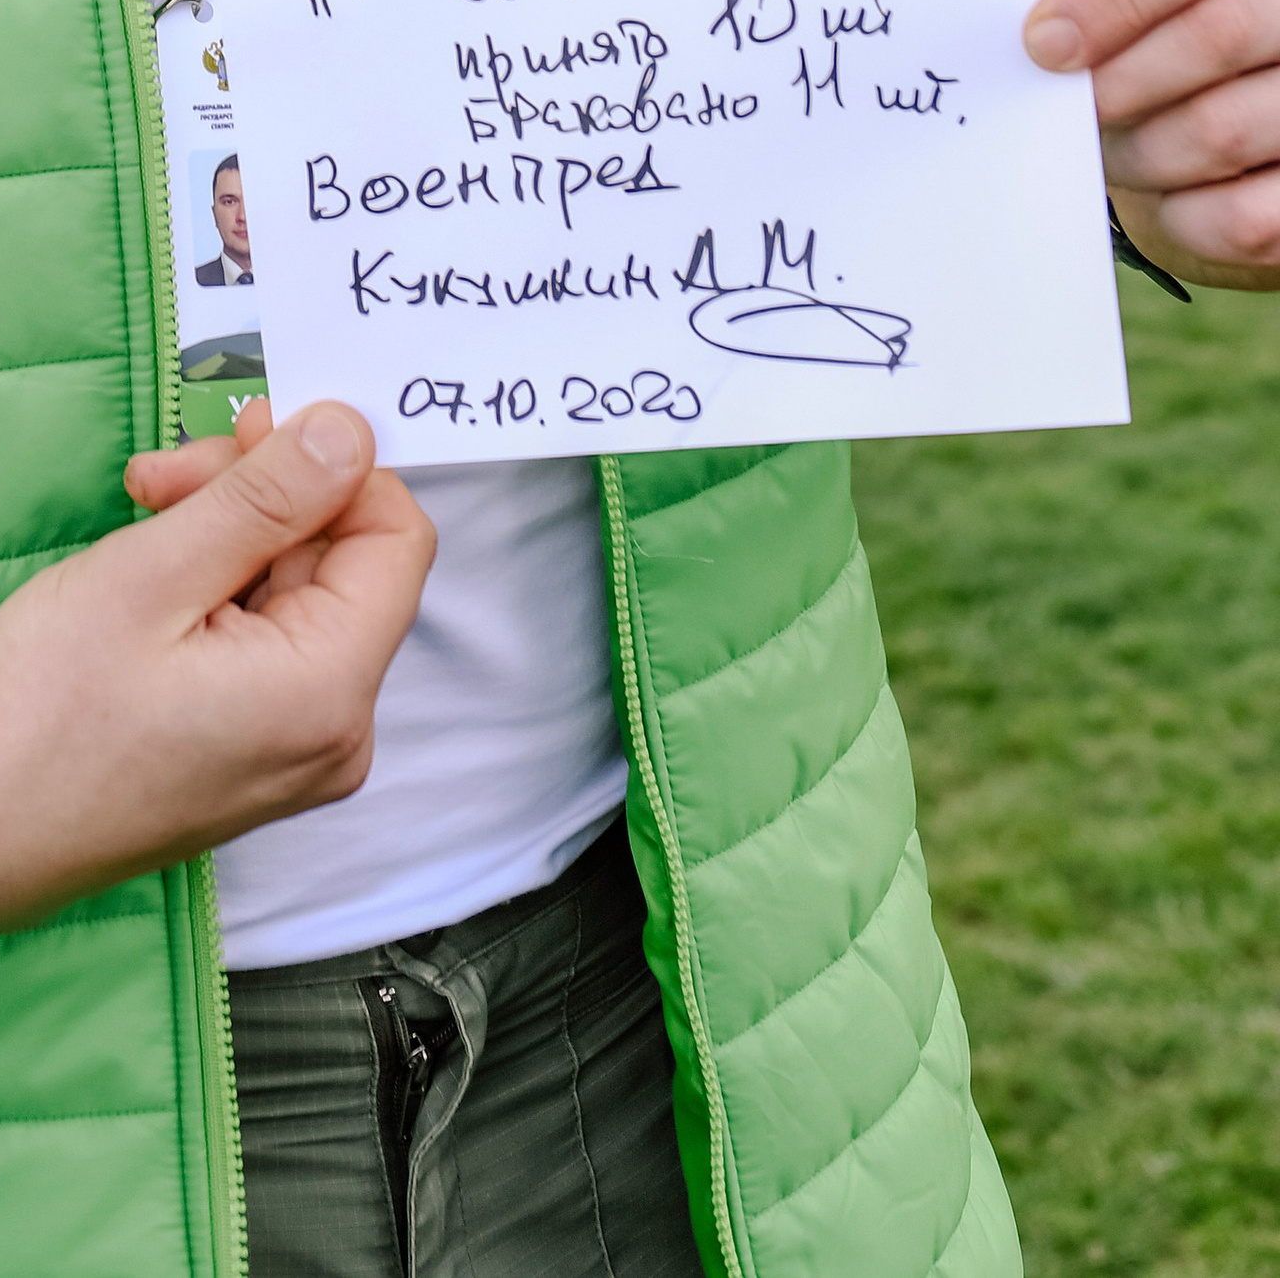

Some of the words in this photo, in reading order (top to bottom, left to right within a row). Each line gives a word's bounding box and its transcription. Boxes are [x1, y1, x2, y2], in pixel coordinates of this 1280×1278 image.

[791, 41, 845, 117] 11
[306, 144, 681, 229] Военпред
[349, 249, 660, 315] Кукушкин
